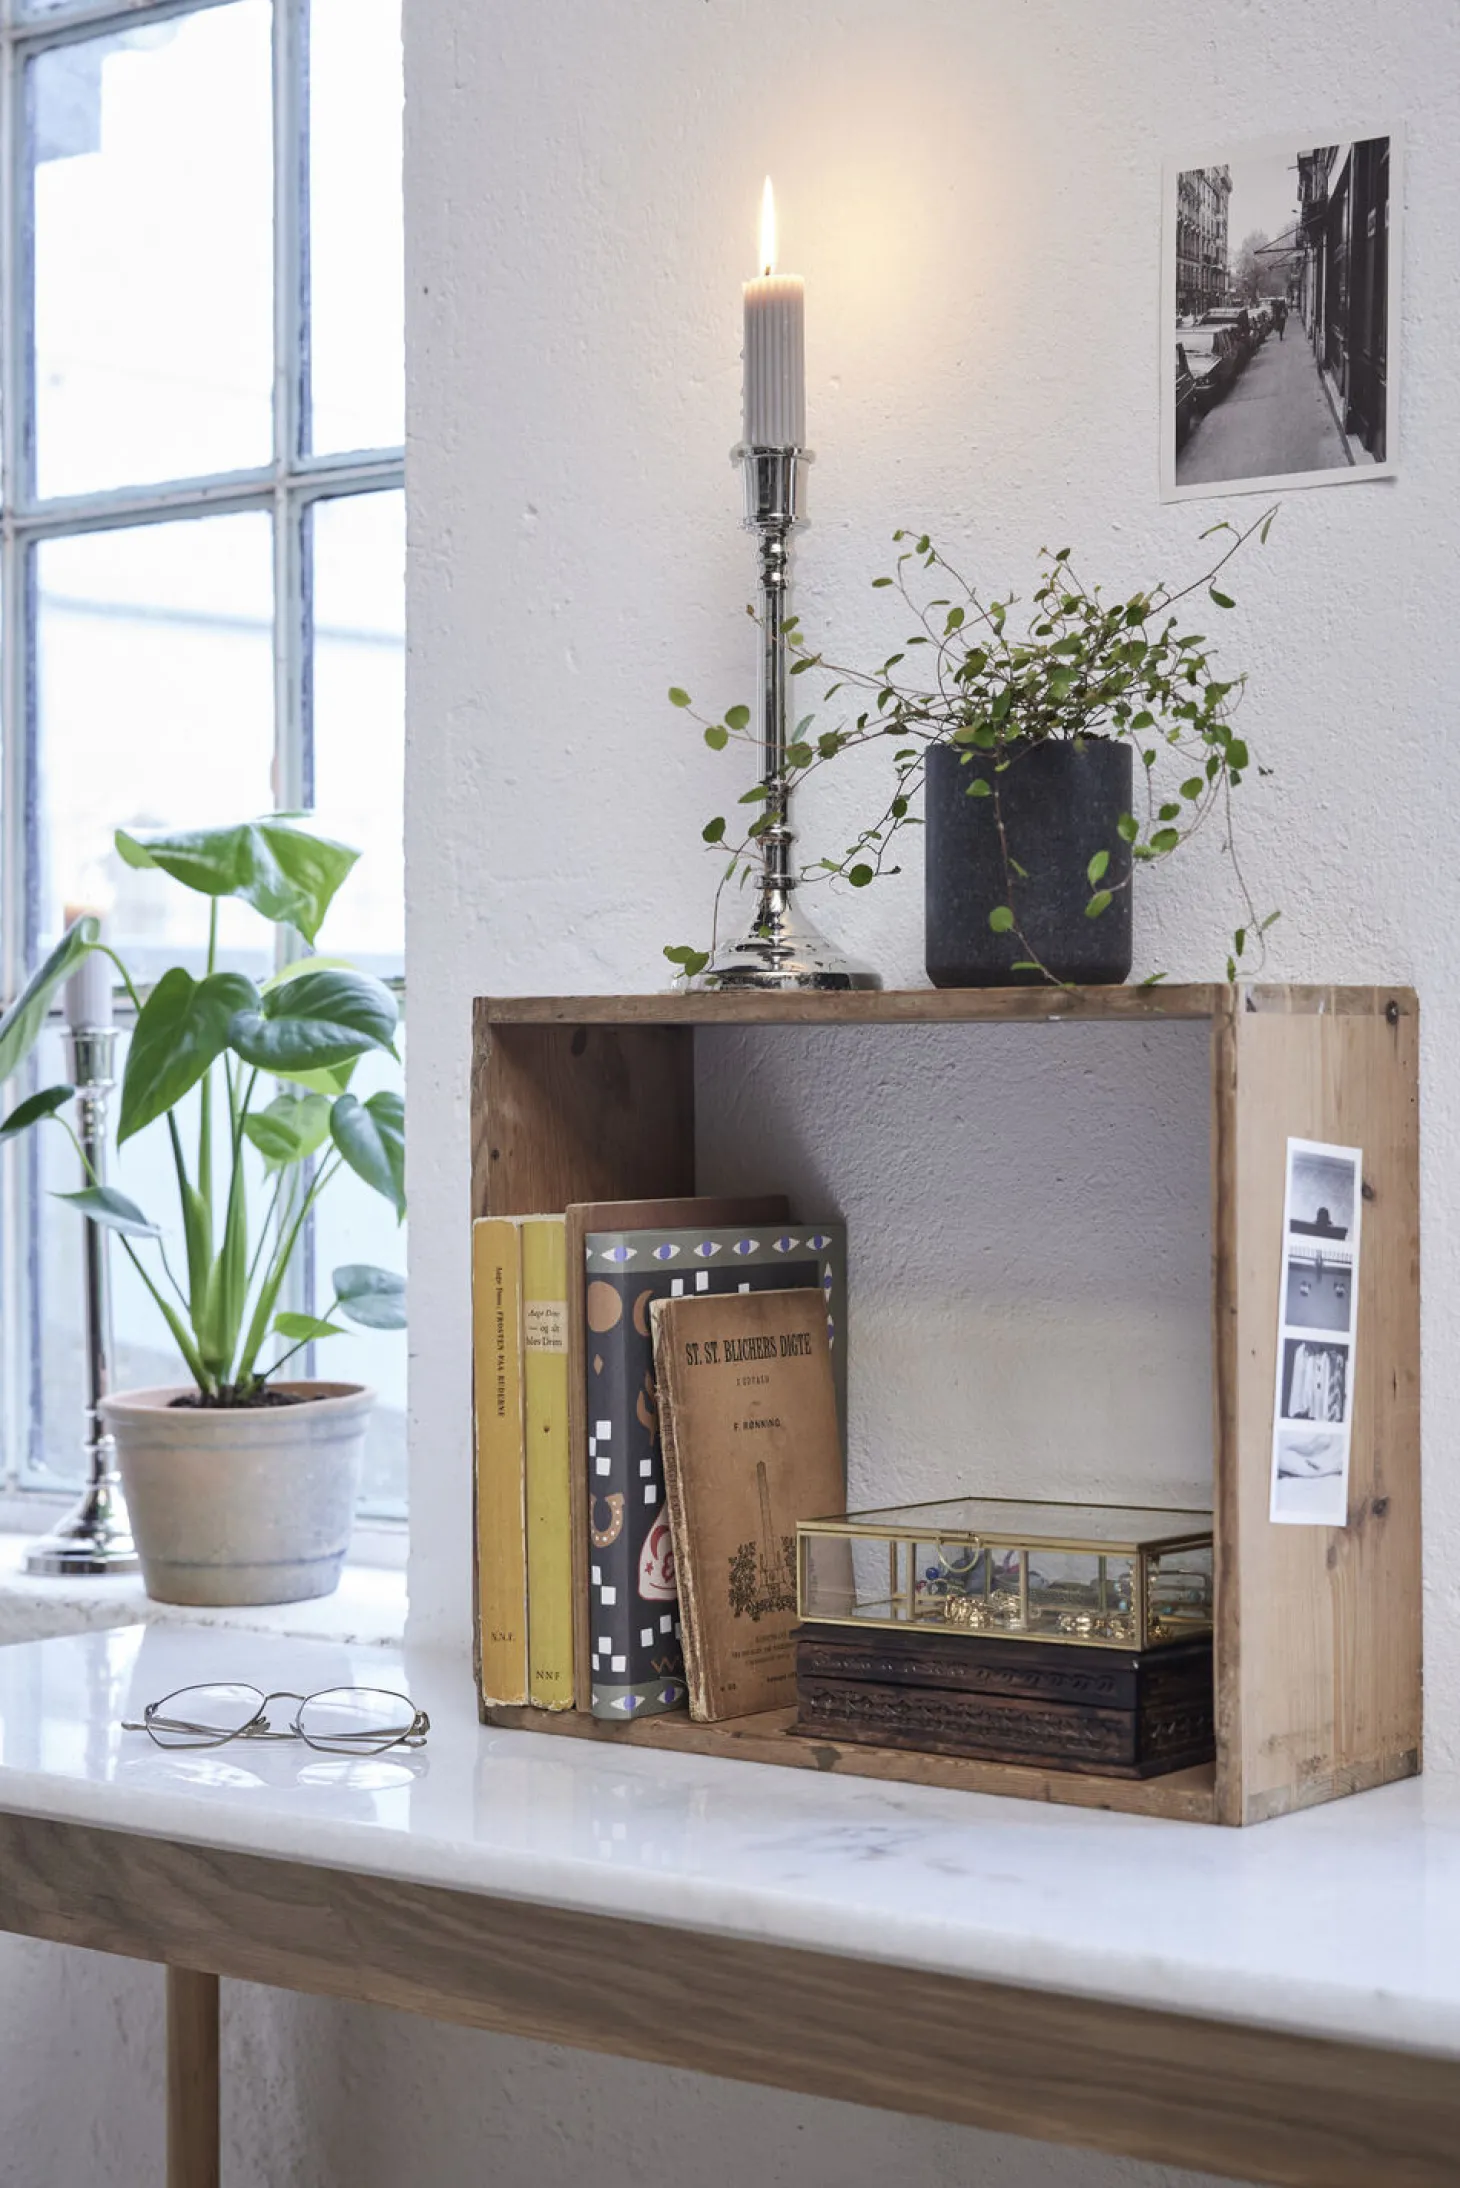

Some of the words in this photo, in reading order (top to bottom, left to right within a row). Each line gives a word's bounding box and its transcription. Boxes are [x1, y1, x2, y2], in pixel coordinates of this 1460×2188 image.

[685, 1342, 702, 1365] ST.
[704, 1341, 721, 1364] ST.
[723, 1335, 778, 1362] BLICHERS
[779, 1332, 812, 1357] DIGTE
